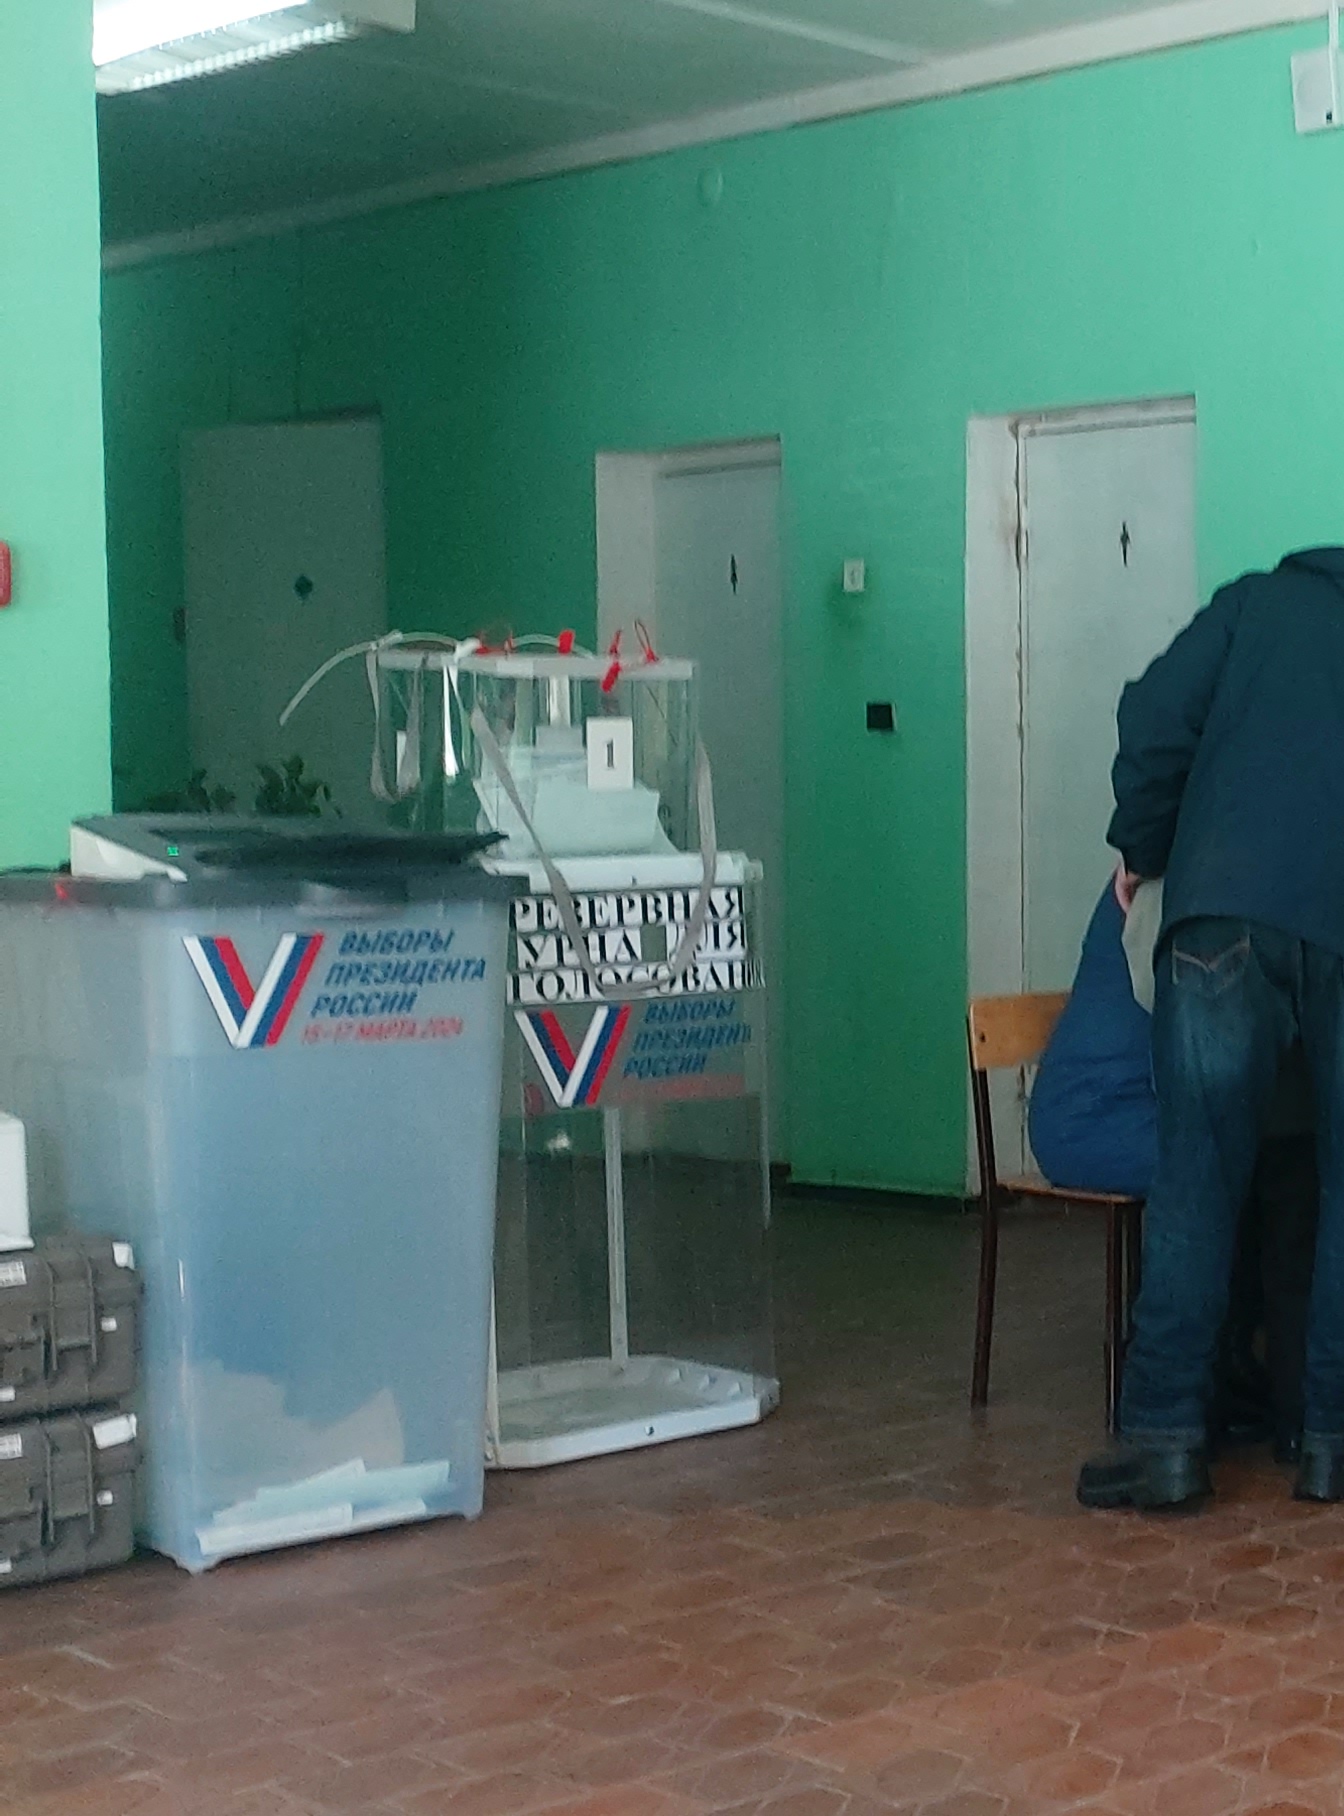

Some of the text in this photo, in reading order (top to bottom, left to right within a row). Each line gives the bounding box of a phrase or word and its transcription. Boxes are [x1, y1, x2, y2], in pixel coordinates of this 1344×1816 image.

[605, 738, 615, 768] 1
[338, 928, 455, 956] ВЫБОРЫ
[324, 957, 487, 988] ПРЕЗИДЕНТА
[309, 989, 418, 1018] РОССИИ
